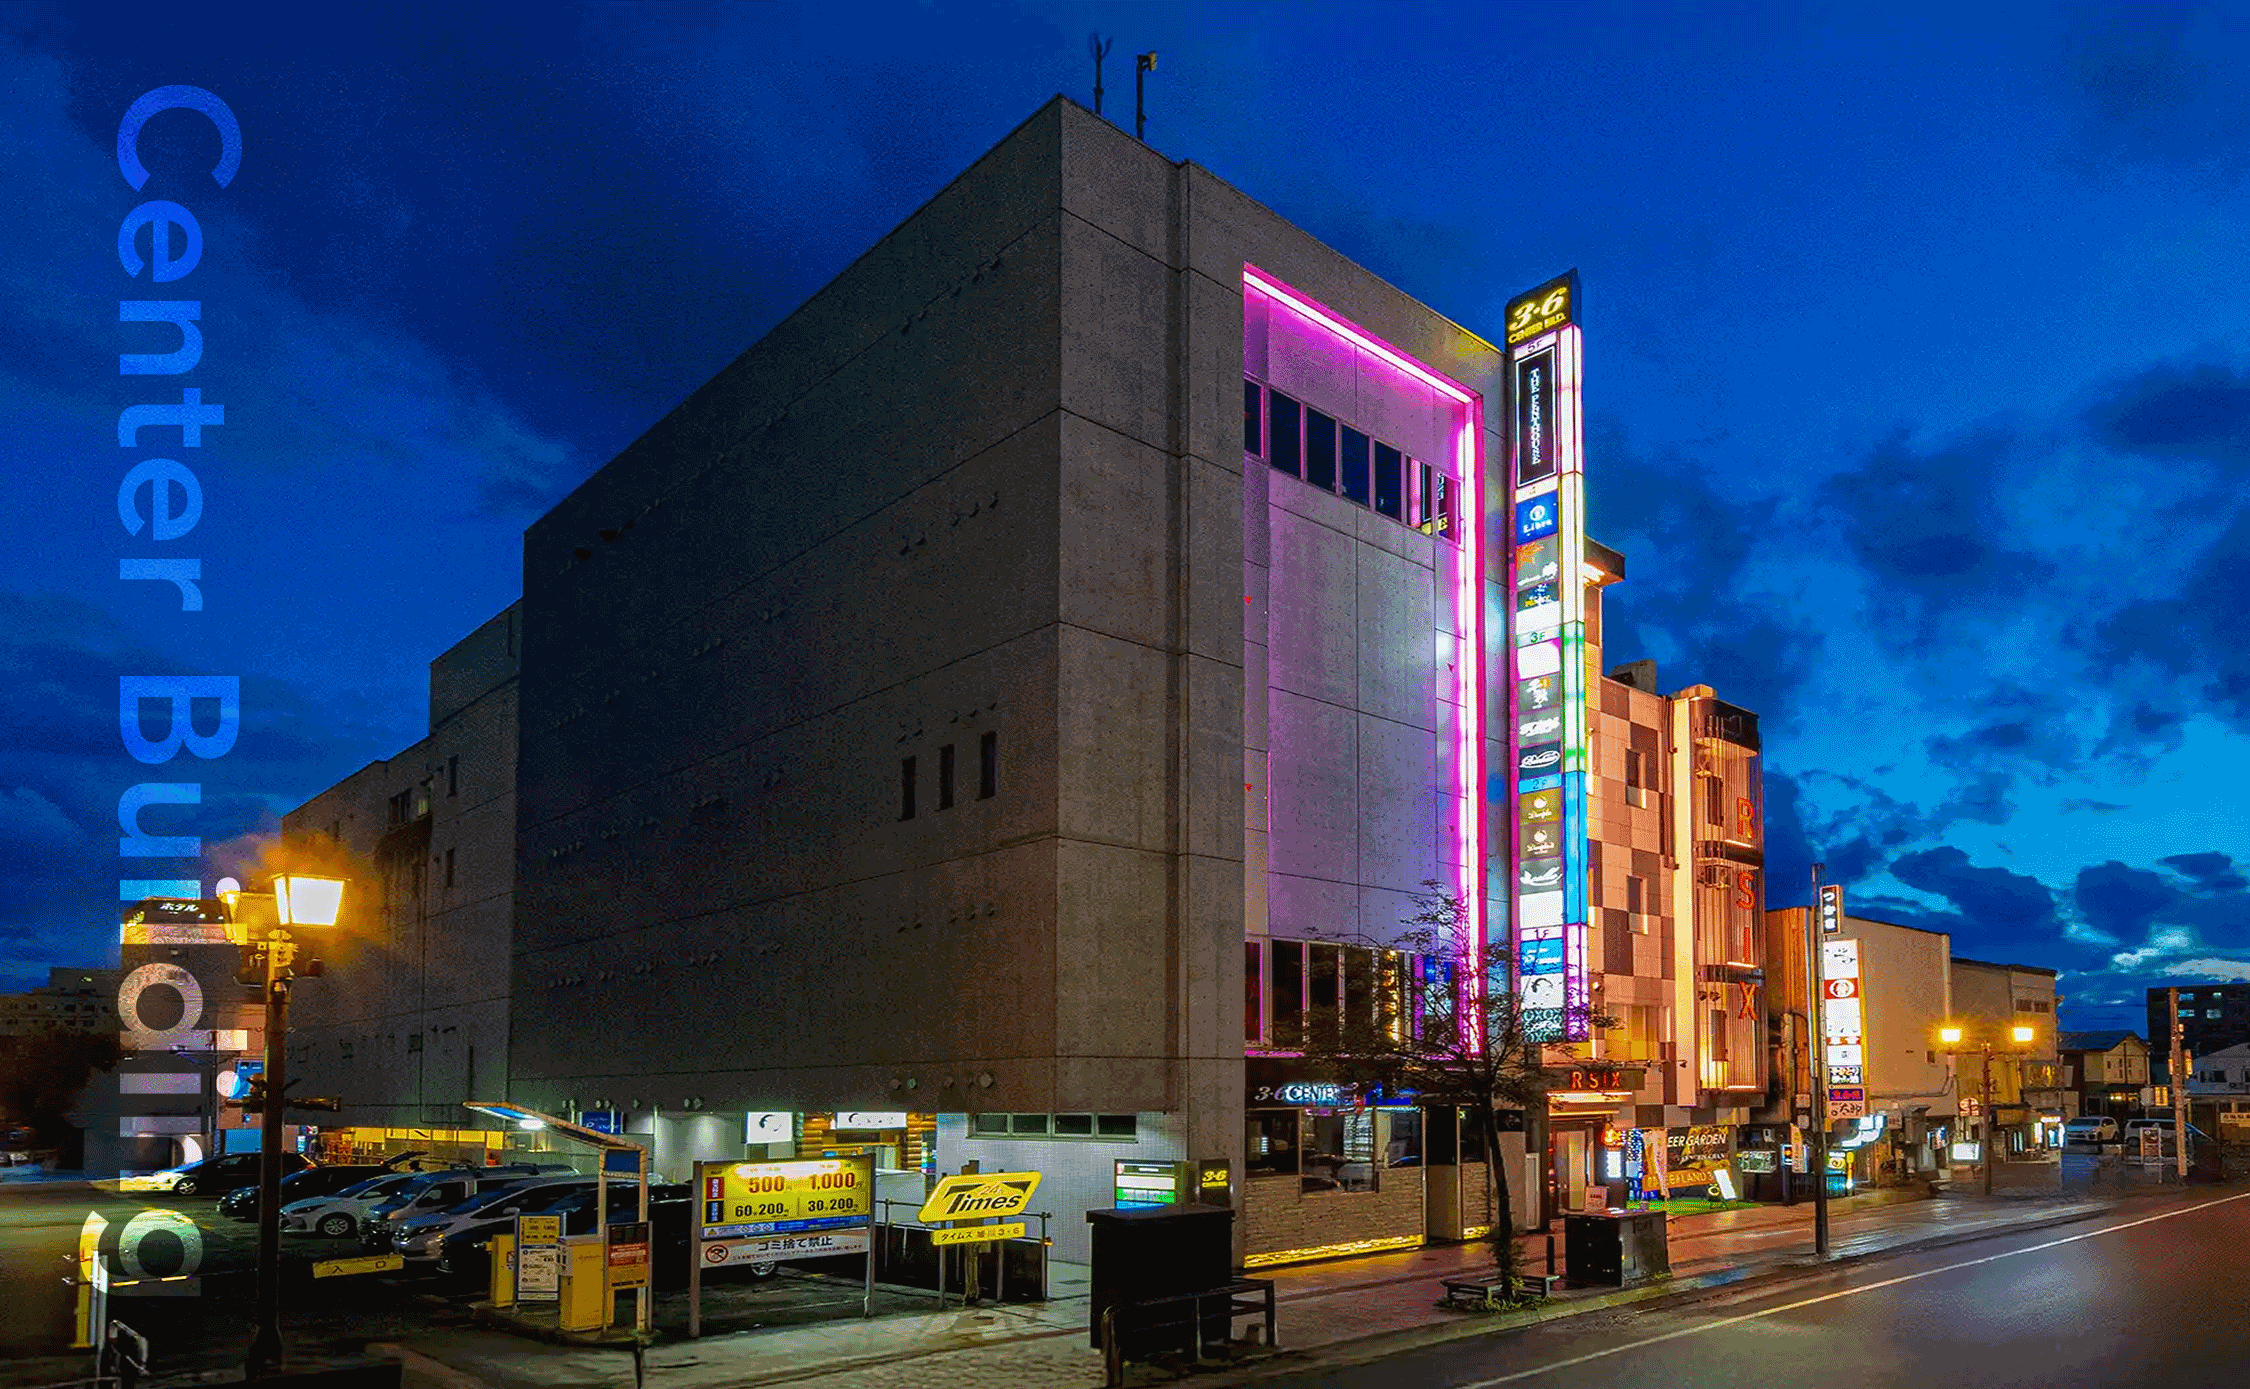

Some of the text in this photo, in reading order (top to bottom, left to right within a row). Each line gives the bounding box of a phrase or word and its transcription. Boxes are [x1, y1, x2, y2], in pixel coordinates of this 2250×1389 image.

[1530, 631, 1546, 644] 3F
[160, 902, 199, 913] ホテル
[1666, 1133, 1727, 1148] EER GARDEN
[748, 1175, 785, 1194] 500
[943, 1180, 1032, 1215] Times
[758, 1235, 834, 1252] ゴミ捨て禁止
